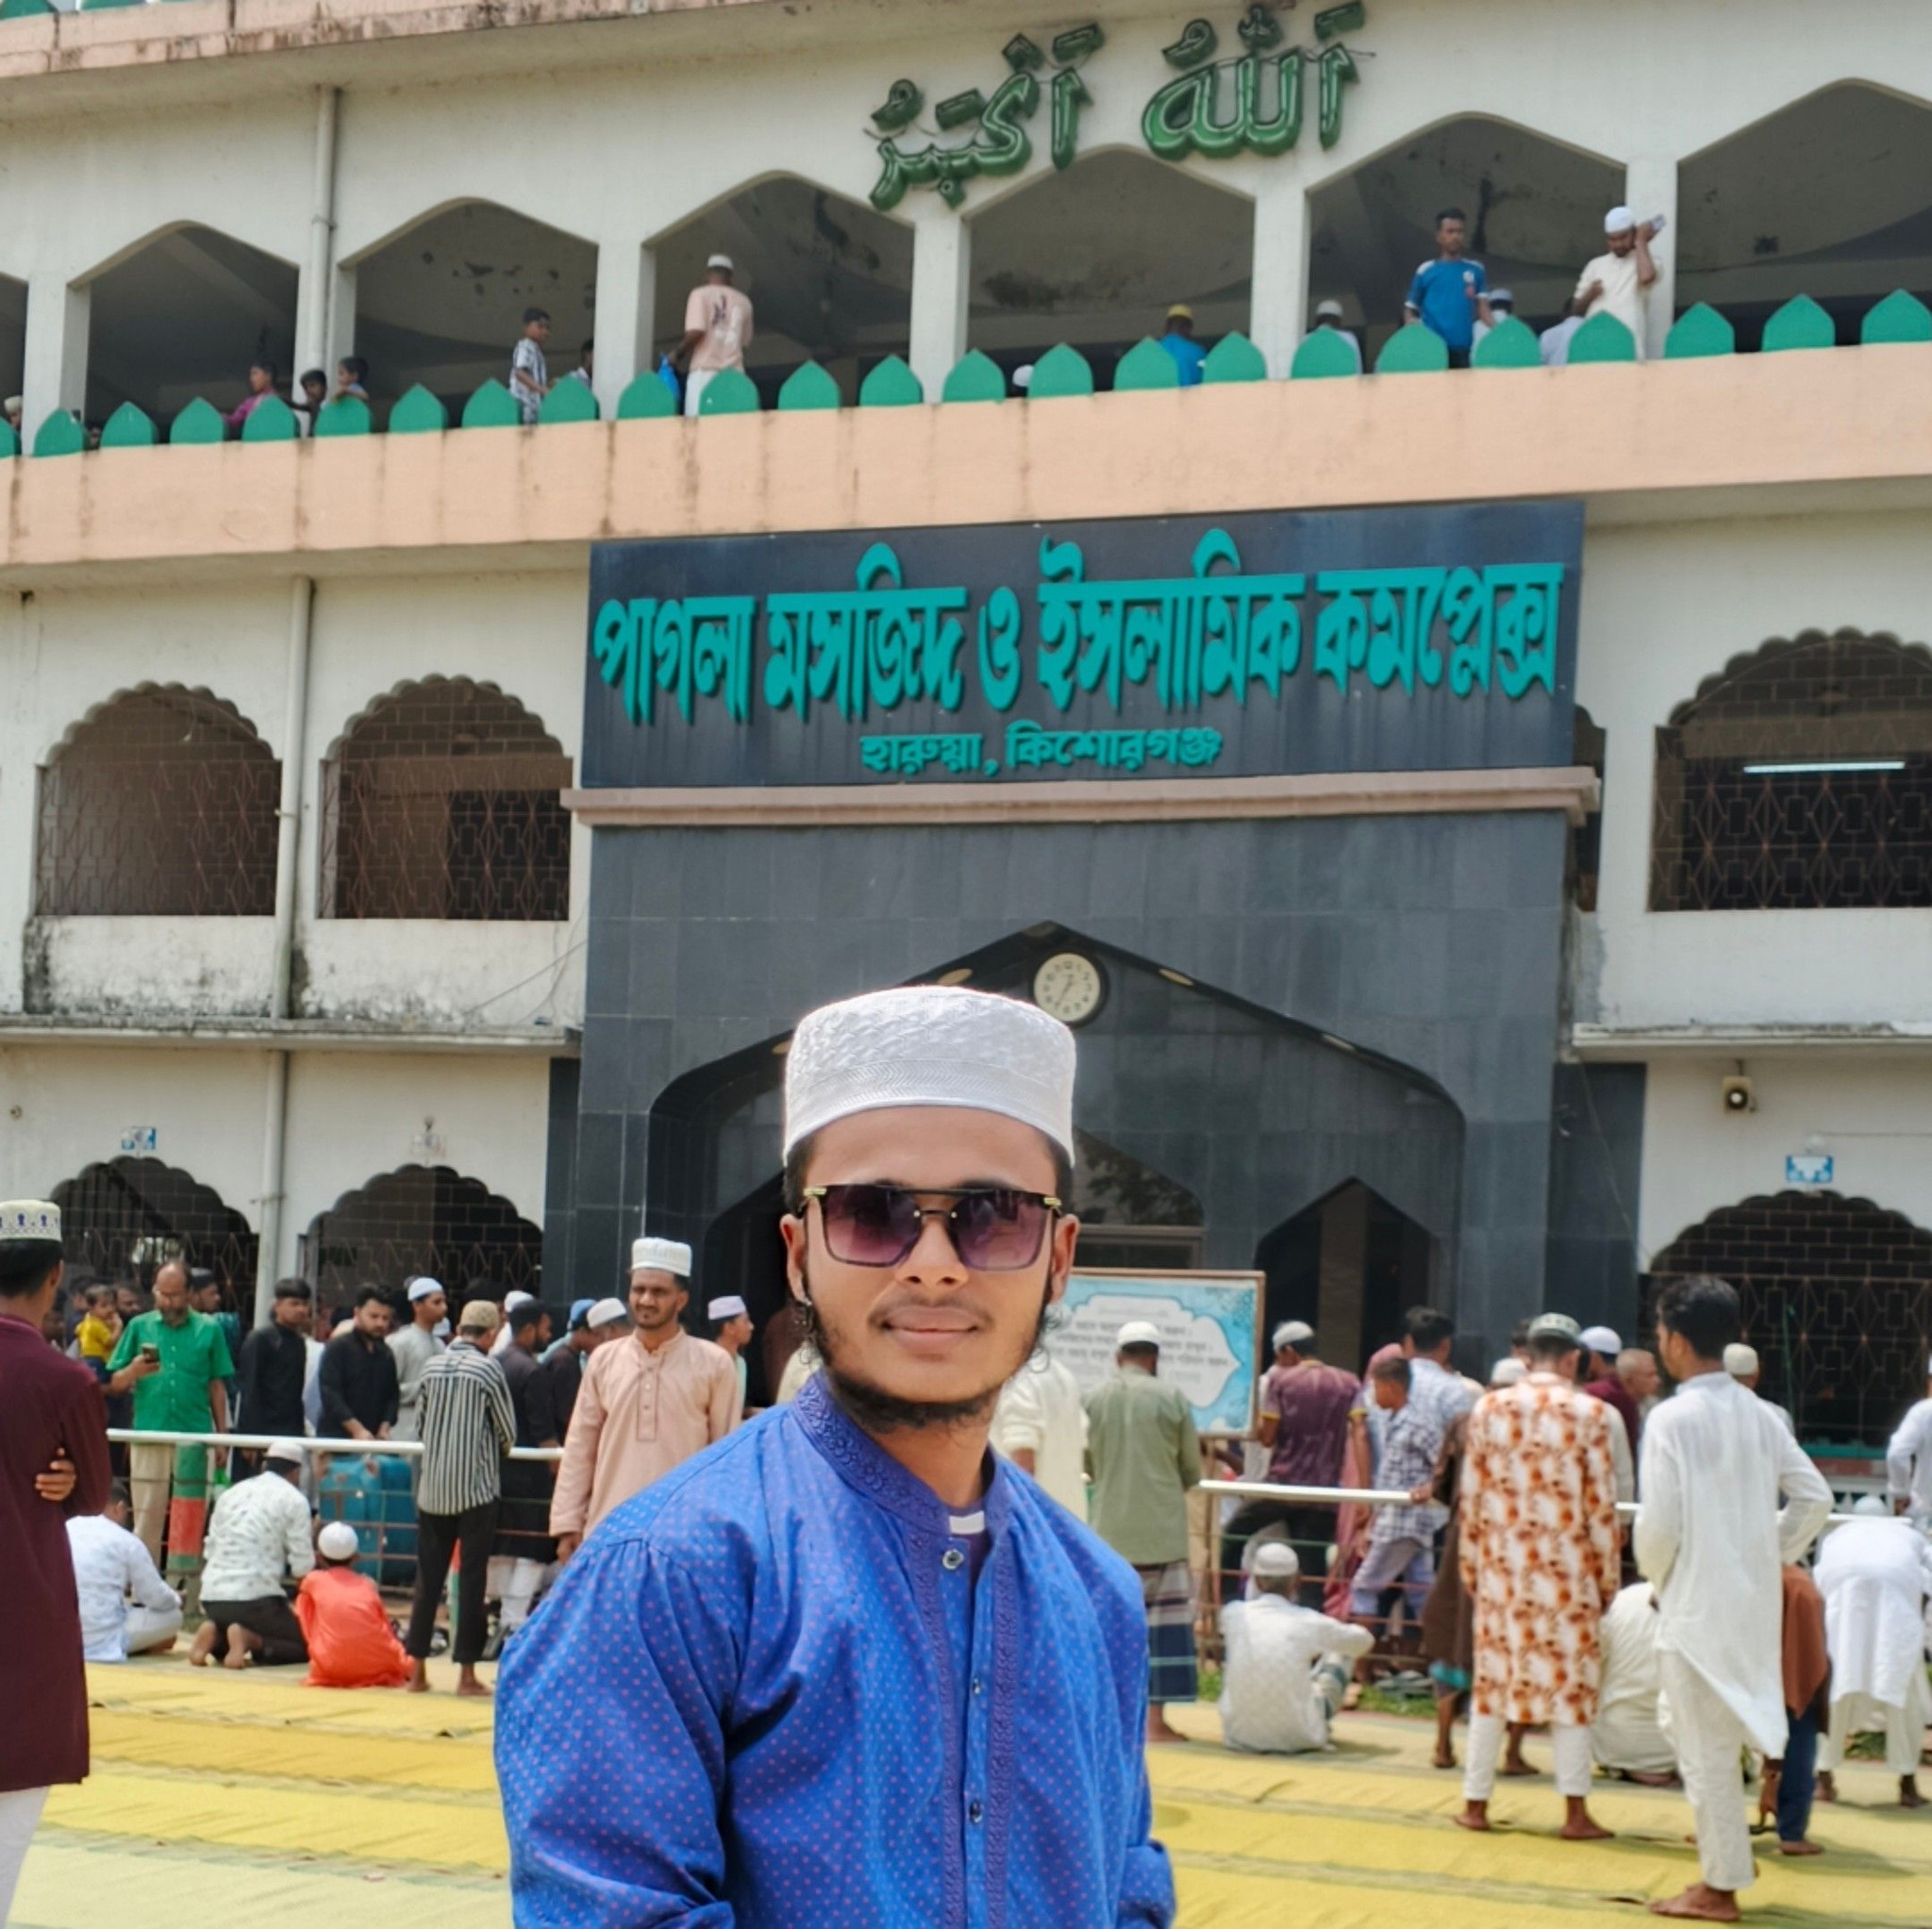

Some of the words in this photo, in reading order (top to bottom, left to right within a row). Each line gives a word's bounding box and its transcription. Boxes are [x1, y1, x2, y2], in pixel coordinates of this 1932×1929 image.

[594, 596, 758, 723] পাগলা
[764, 543, 969, 720] মসজিদ
[977, 587, 1022, 711] ও
[1037, 528, 1307, 711] ইসলামিক
[1314, 562, 1566, 698] কমপ্লেক্স
[1006, 719, 1224, 772] কিশোরগঞ্জ
